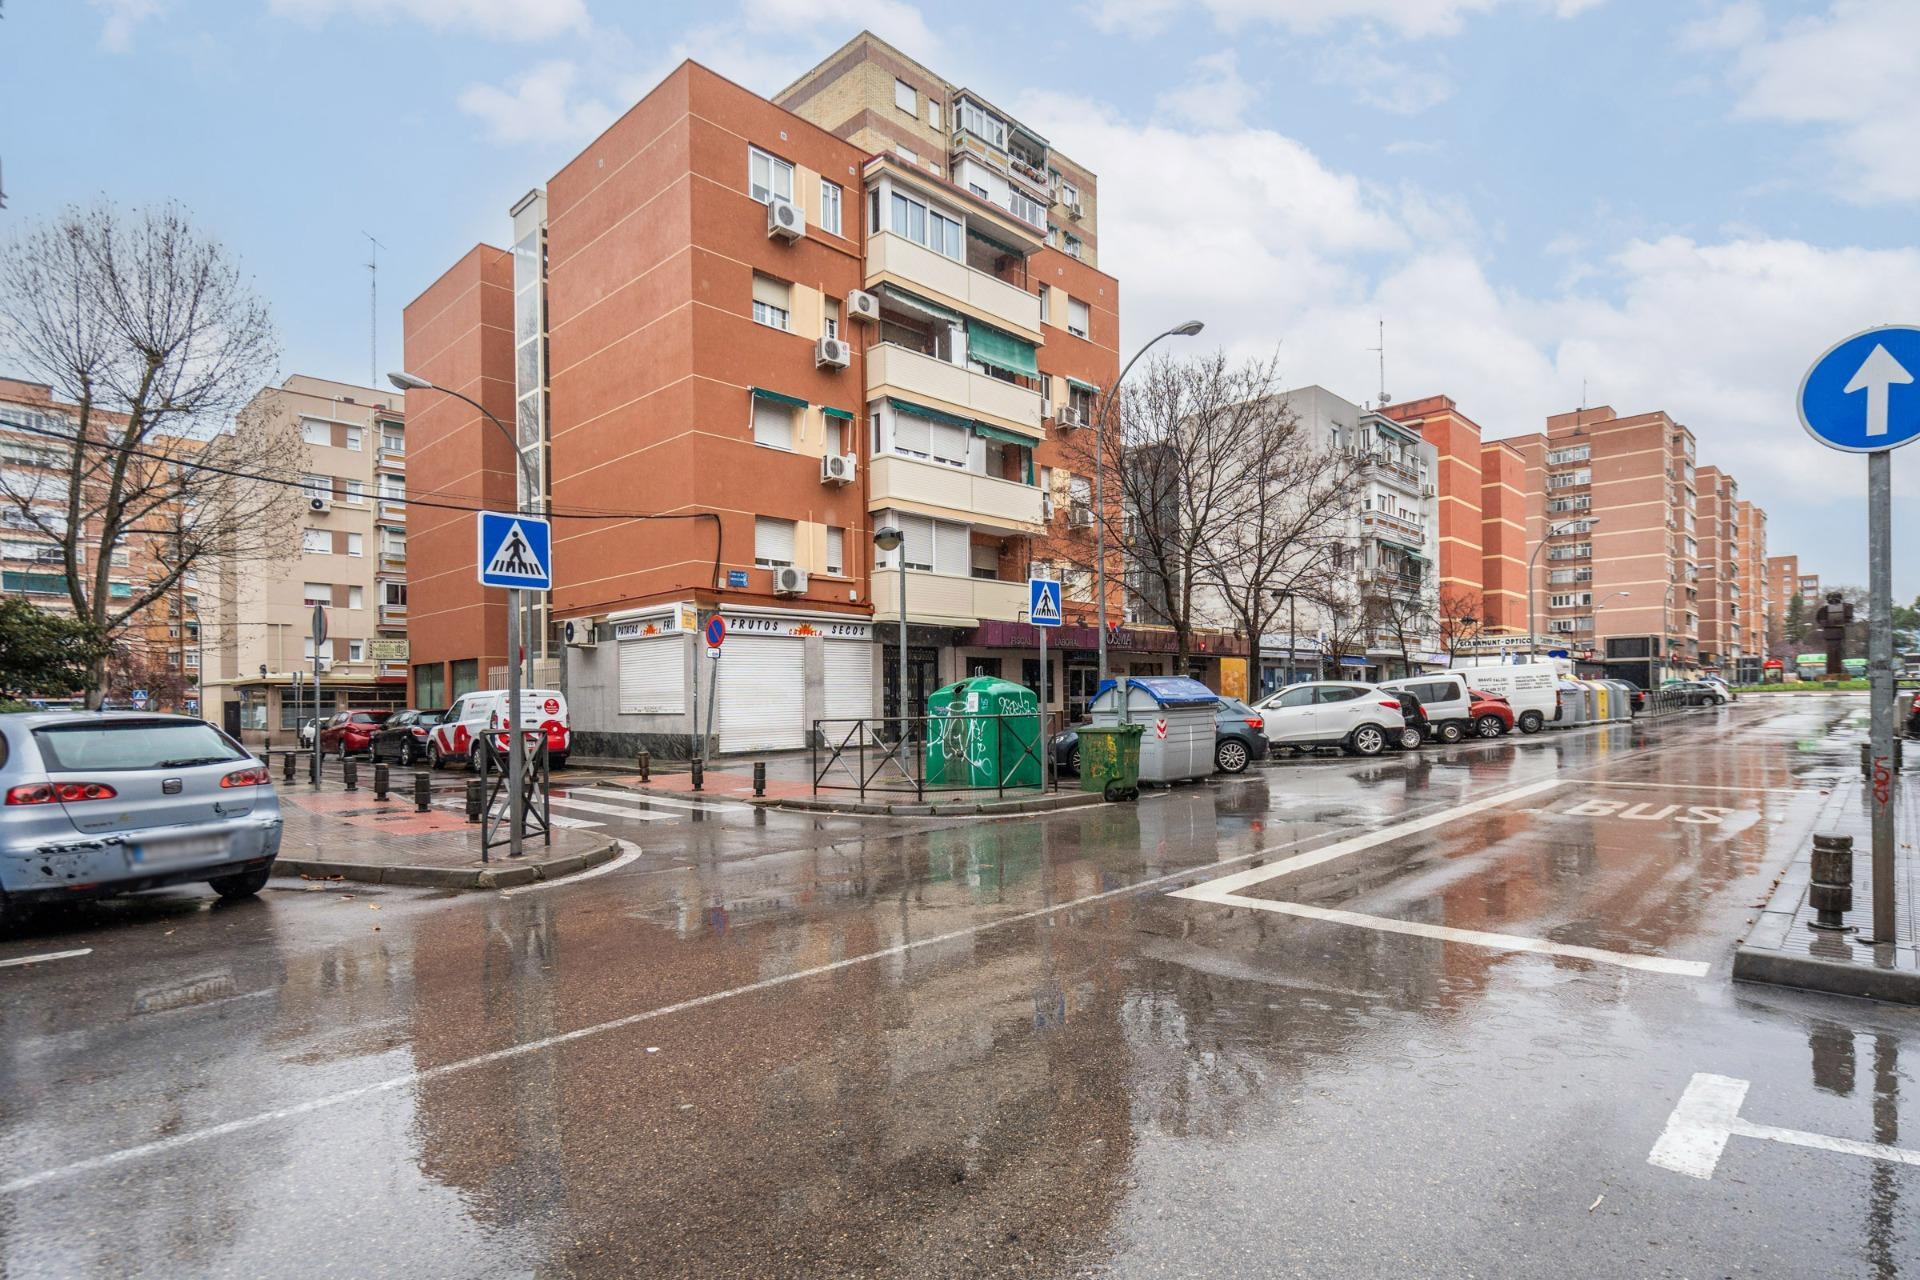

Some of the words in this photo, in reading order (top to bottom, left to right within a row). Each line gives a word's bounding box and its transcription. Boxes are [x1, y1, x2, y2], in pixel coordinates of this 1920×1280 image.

[618, 625, 638, 636] PATATAS
[731, 619, 779, 631] FRUTOS
[831, 625, 865, 636] SECOS
[1563, 799, 1735, 824] BUS
